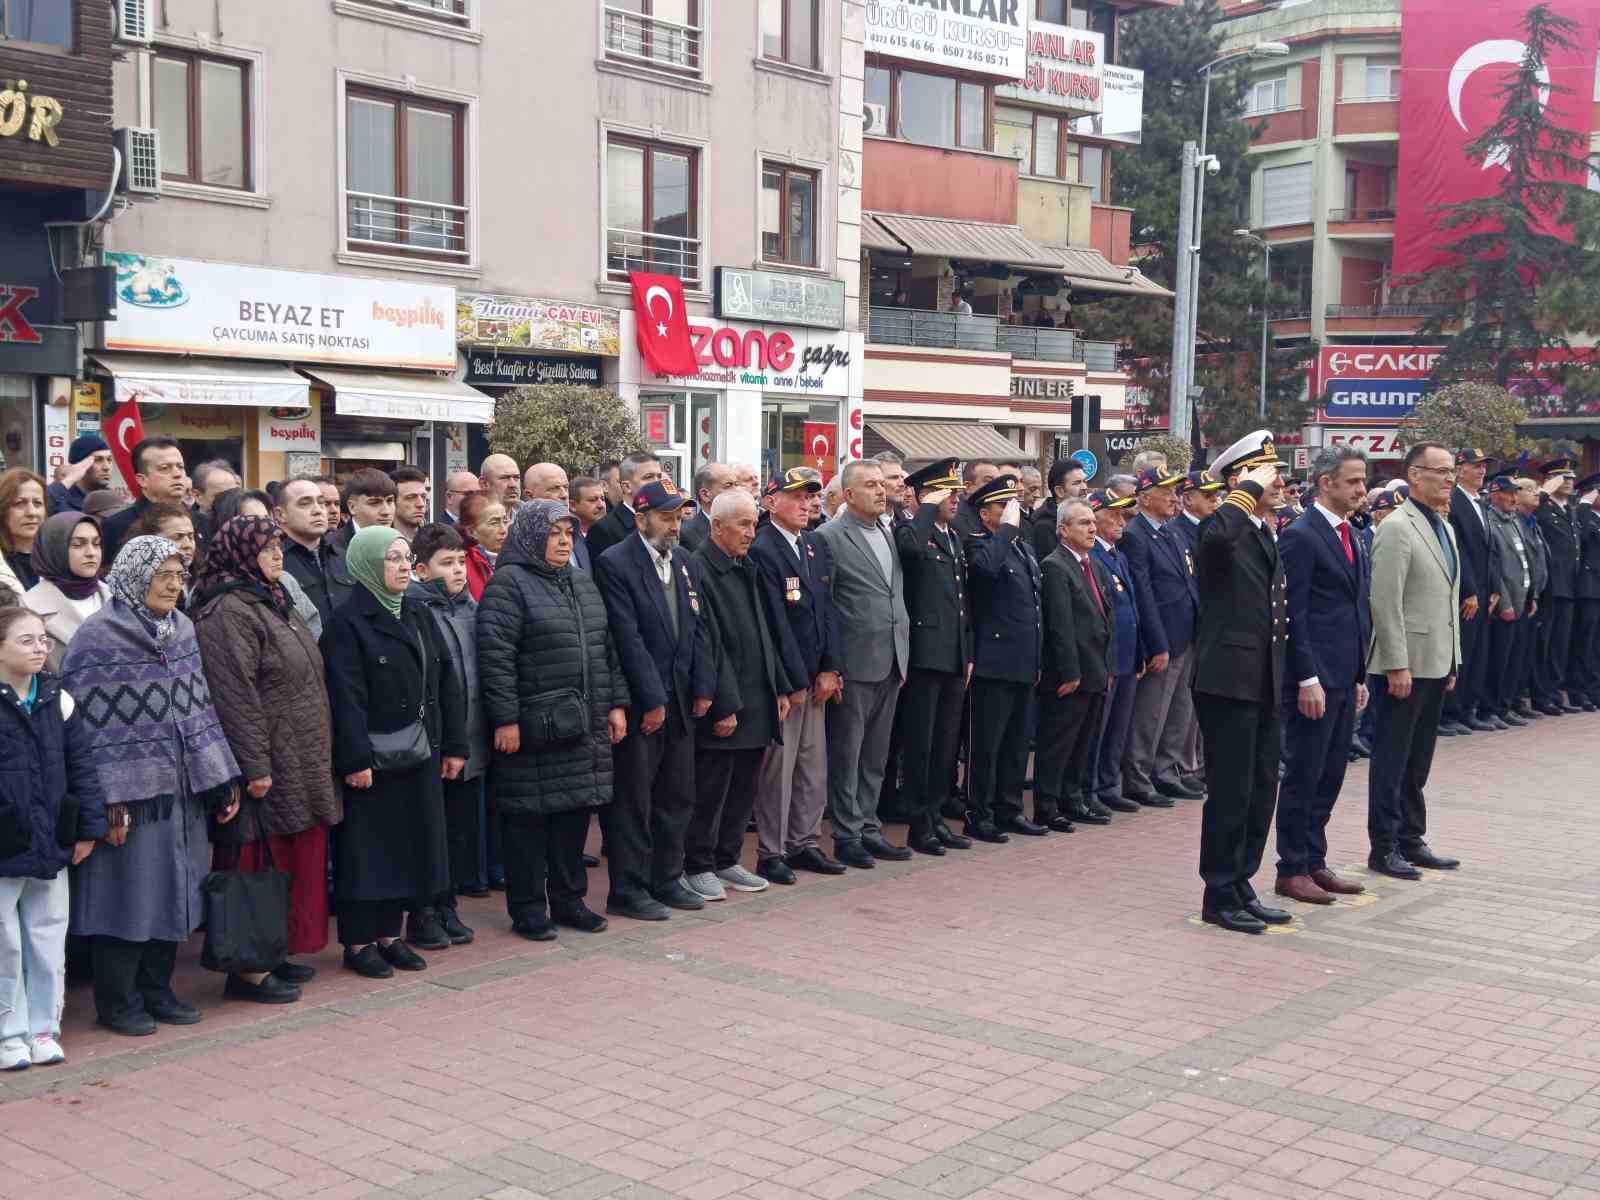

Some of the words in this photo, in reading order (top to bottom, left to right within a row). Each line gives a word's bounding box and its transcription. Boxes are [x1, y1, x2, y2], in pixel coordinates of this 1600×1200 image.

[943, 20, 1010, 51] KURSU
[889, 35, 907, 47] 615
[943, 45, 964, 57] 0507
[967, 49, 983, 62] 245
[998, 55, 1009, 67] 71
[1048, 68, 1100, 100] KURSU
[239, 300, 312, 326] BEYAZ
[320, 307, 345, 329] ET
[212, 327, 278, 343] ÇAYCUMA
[281, 332, 315, 349] SATIŞ
[318, 335, 369, 350] NOKTASI
[473, 359, 494, 375] Best
[527, 360, 536, 377] &
[569, 363, 598, 380] Salonu
[740, 373, 768, 386] vitamin
[773, 376, 793, 388] anne
[800, 376, 824, 389] bebek
[270, 422, 316, 441] beypiliç
